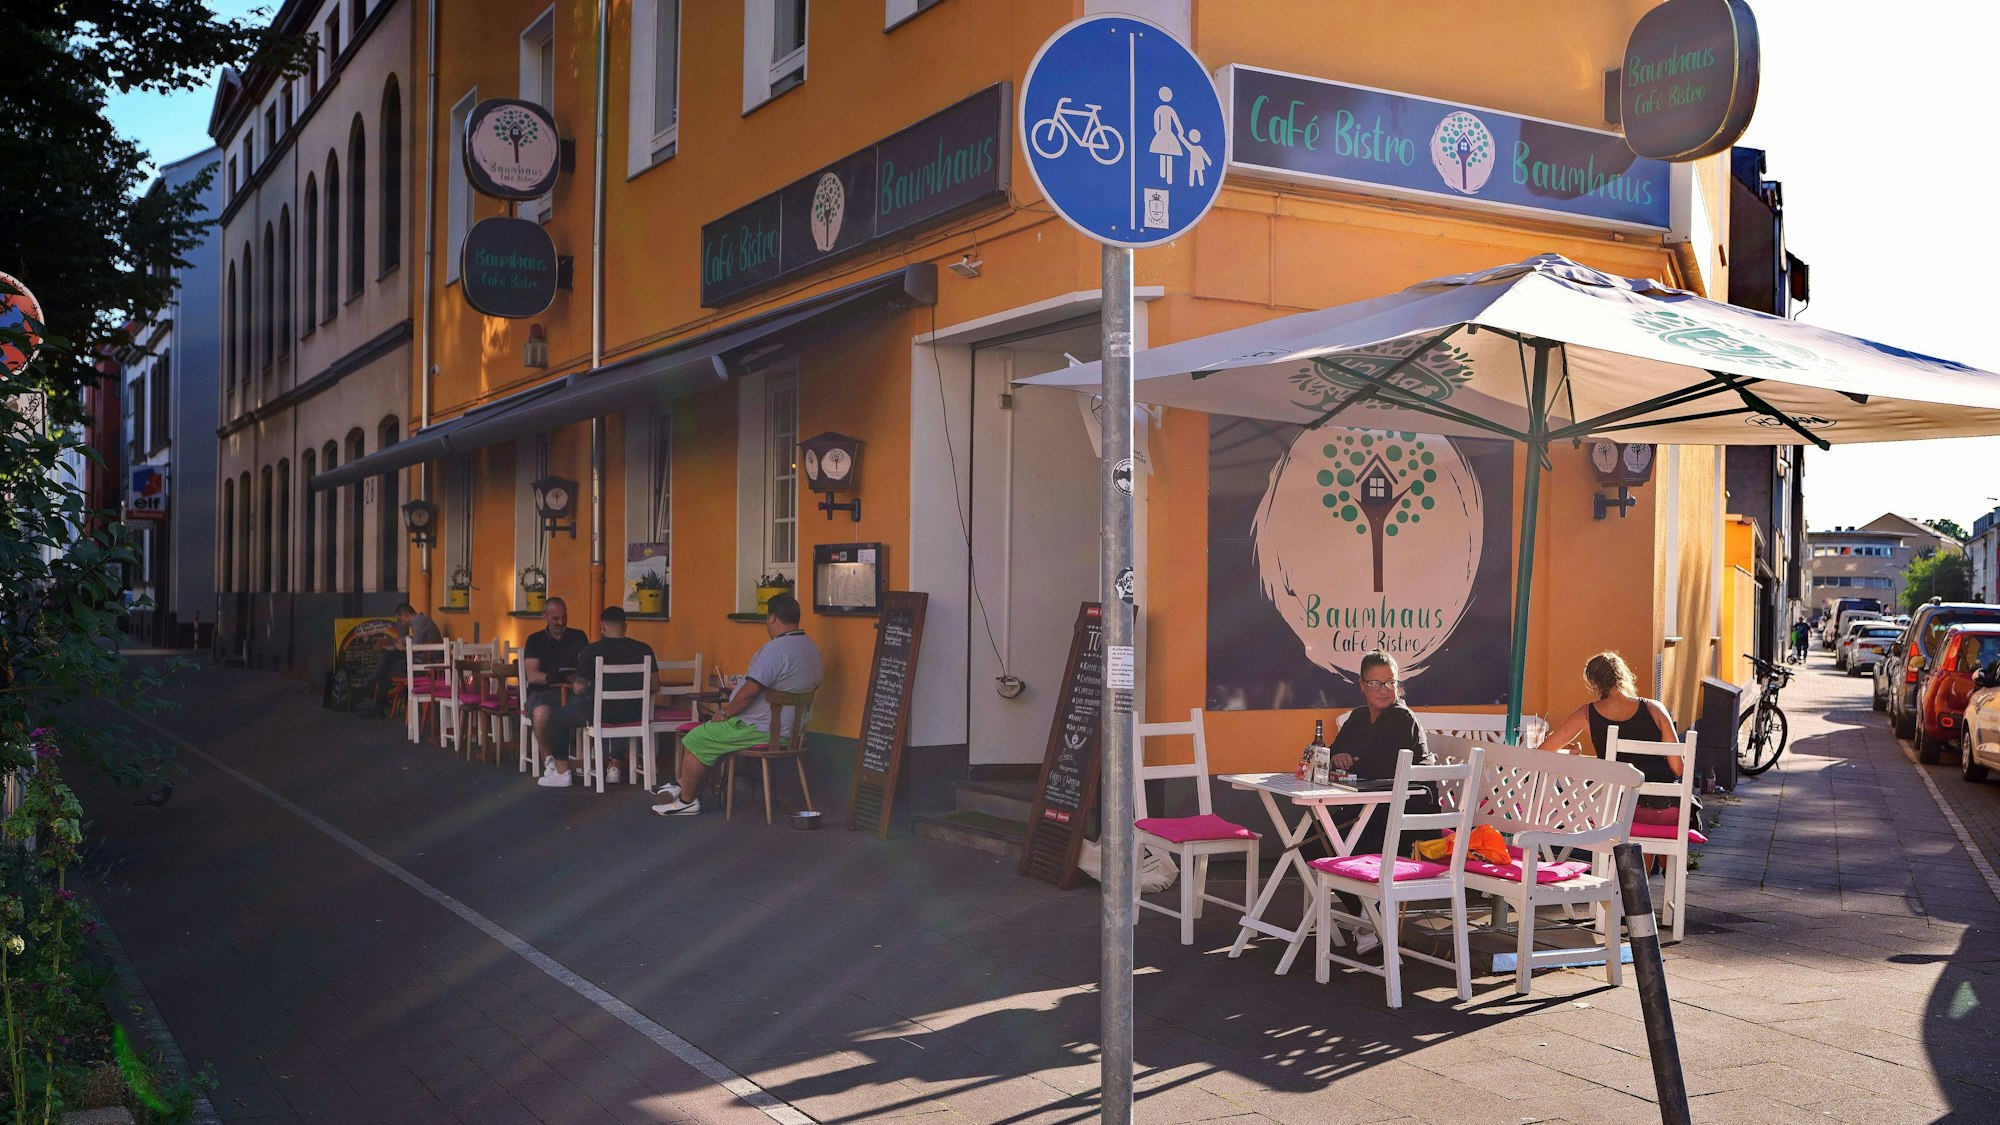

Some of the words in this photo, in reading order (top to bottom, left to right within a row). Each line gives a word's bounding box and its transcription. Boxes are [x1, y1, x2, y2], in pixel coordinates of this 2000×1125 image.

[1628, 44, 1715, 88] Baumhaus
[1669, 81, 1706, 108] Bistro
[1336, 109, 1415, 166] Bistro
[1512, 140, 1653, 206] Baumhaus
[739, 216, 778, 271] Bistro
[880, 136, 993, 216] Baumhaus
[475, 245, 547, 272] Baumhaus
[134, 497, 161, 509] elf
[1306, 593, 1444, 629] Baumhaus
[1377, 630, 1420, 652] Bistro
